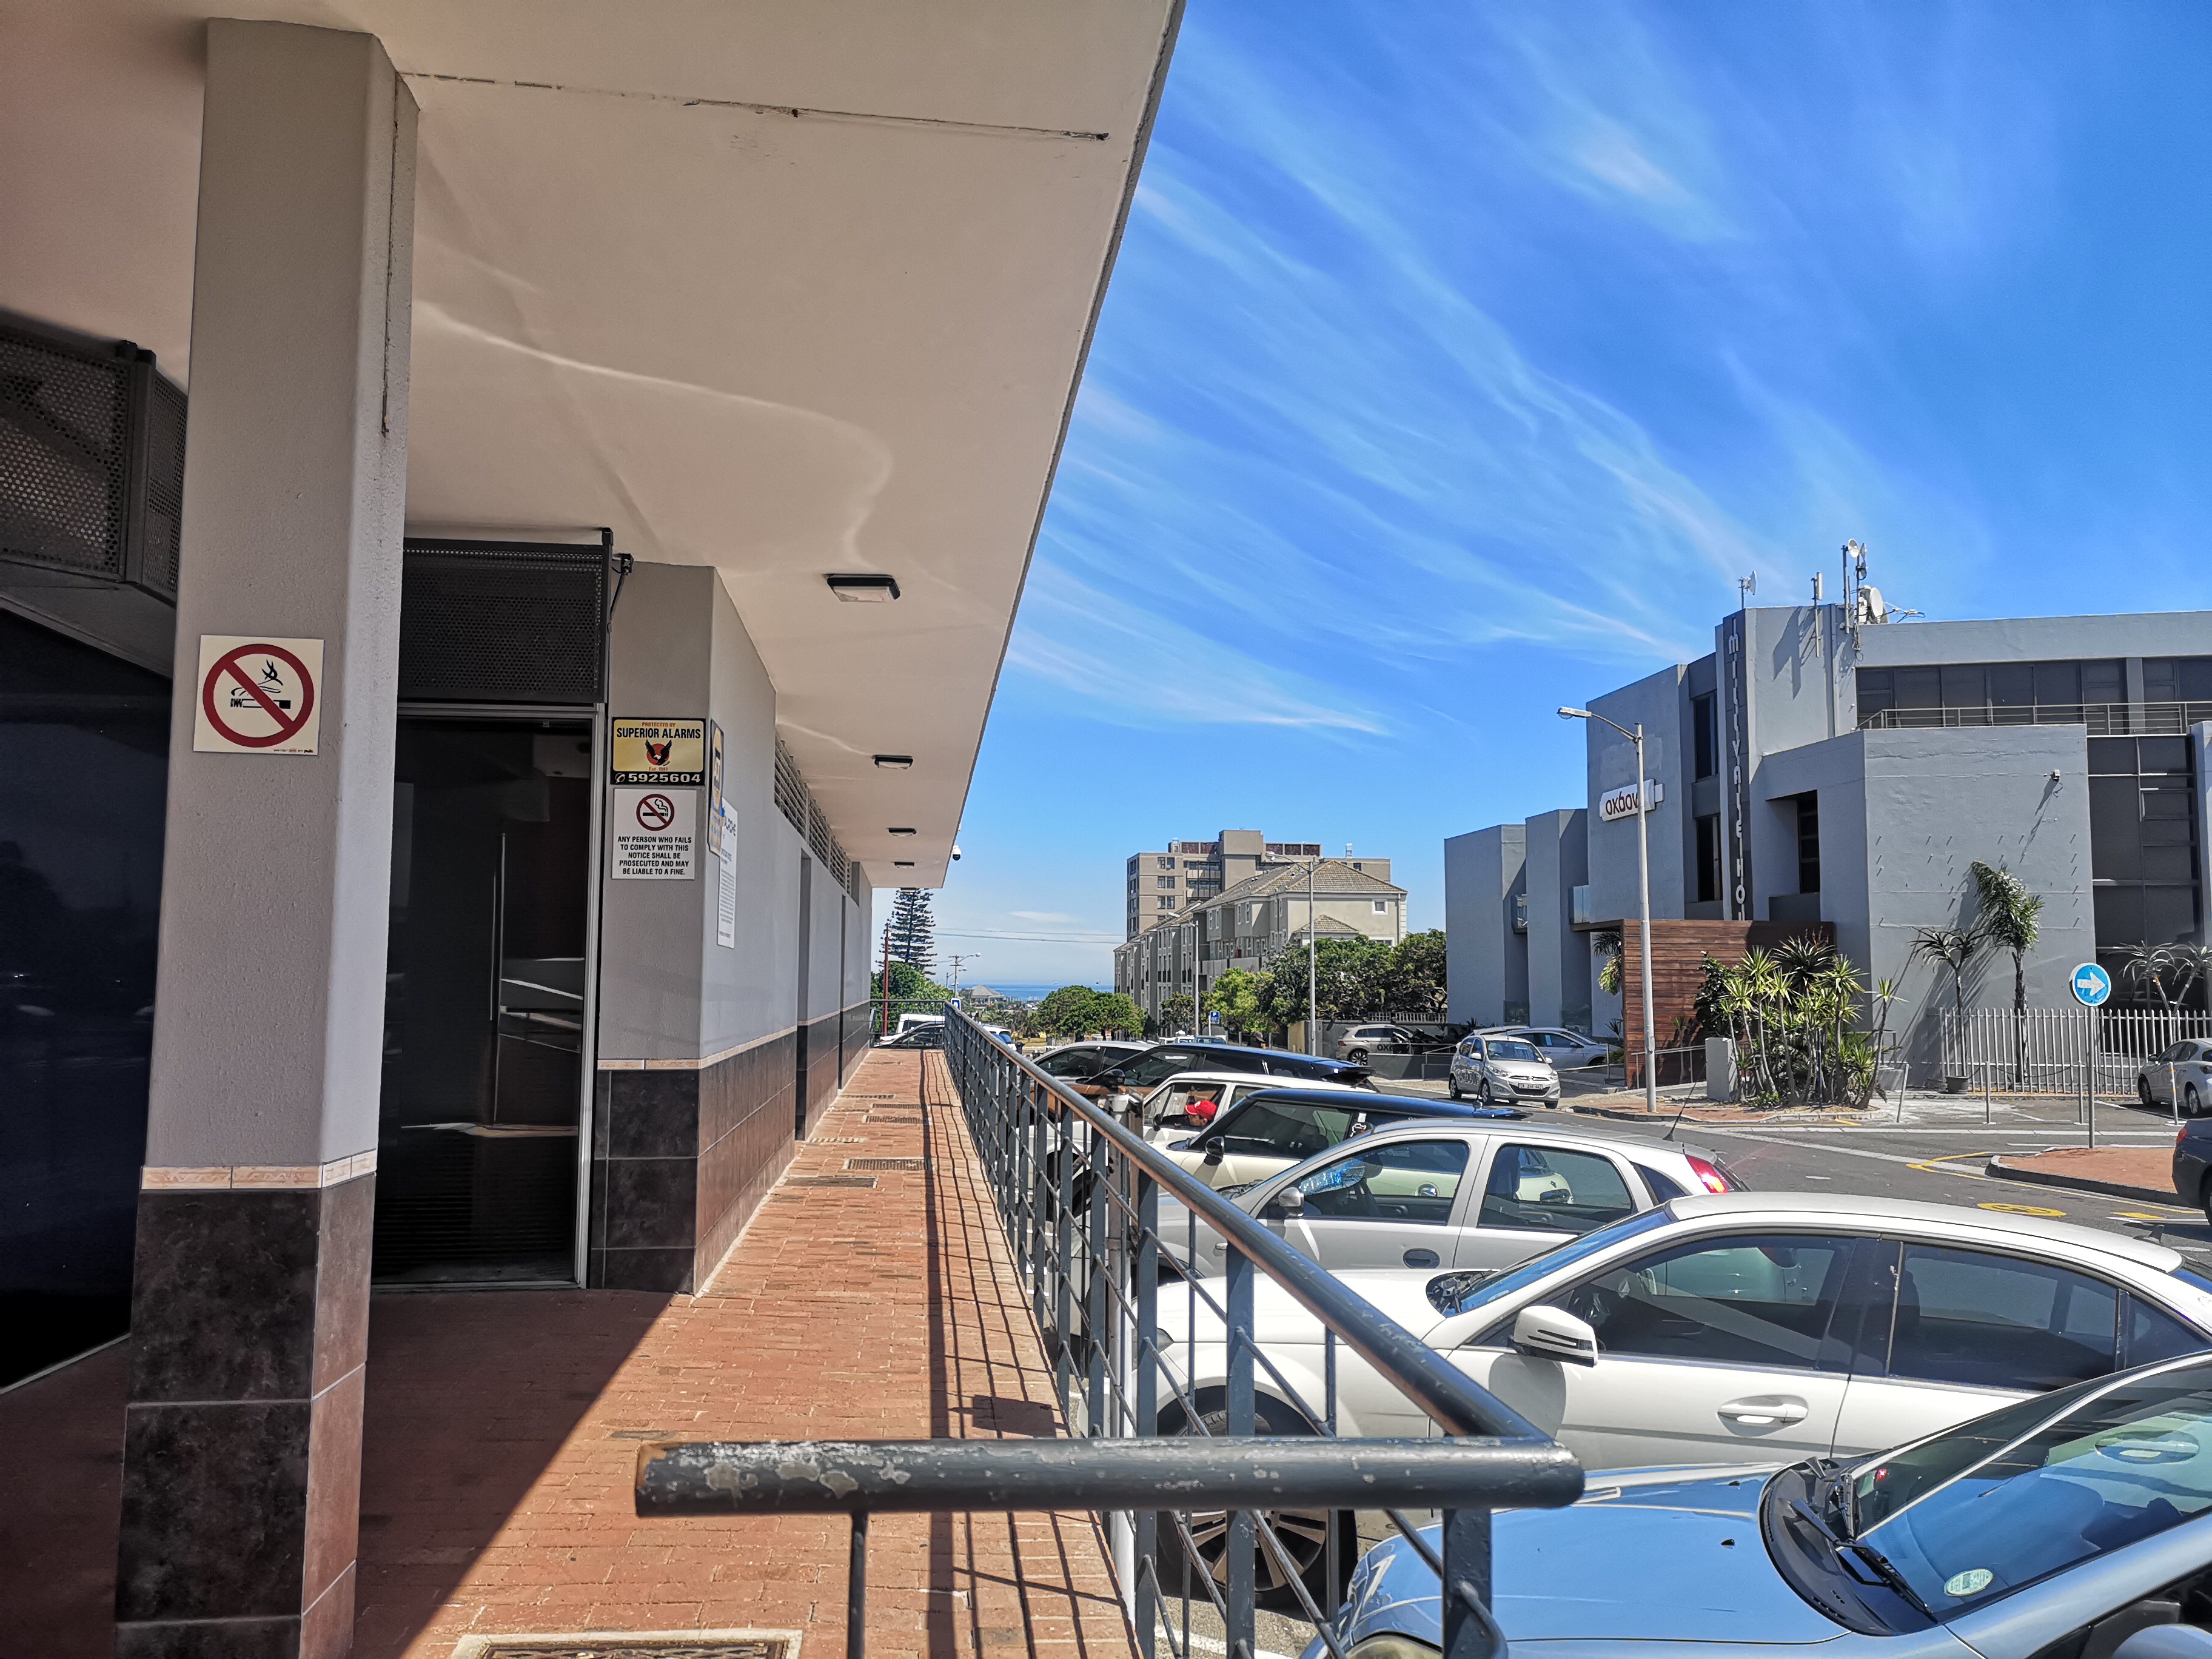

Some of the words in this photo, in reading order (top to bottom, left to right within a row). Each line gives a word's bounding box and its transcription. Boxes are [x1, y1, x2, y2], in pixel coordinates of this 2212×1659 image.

[617, 728, 659, 738] SUPERIOR
[662, 728, 701, 739] ALARMS
[628, 773, 701, 783] 5925604
